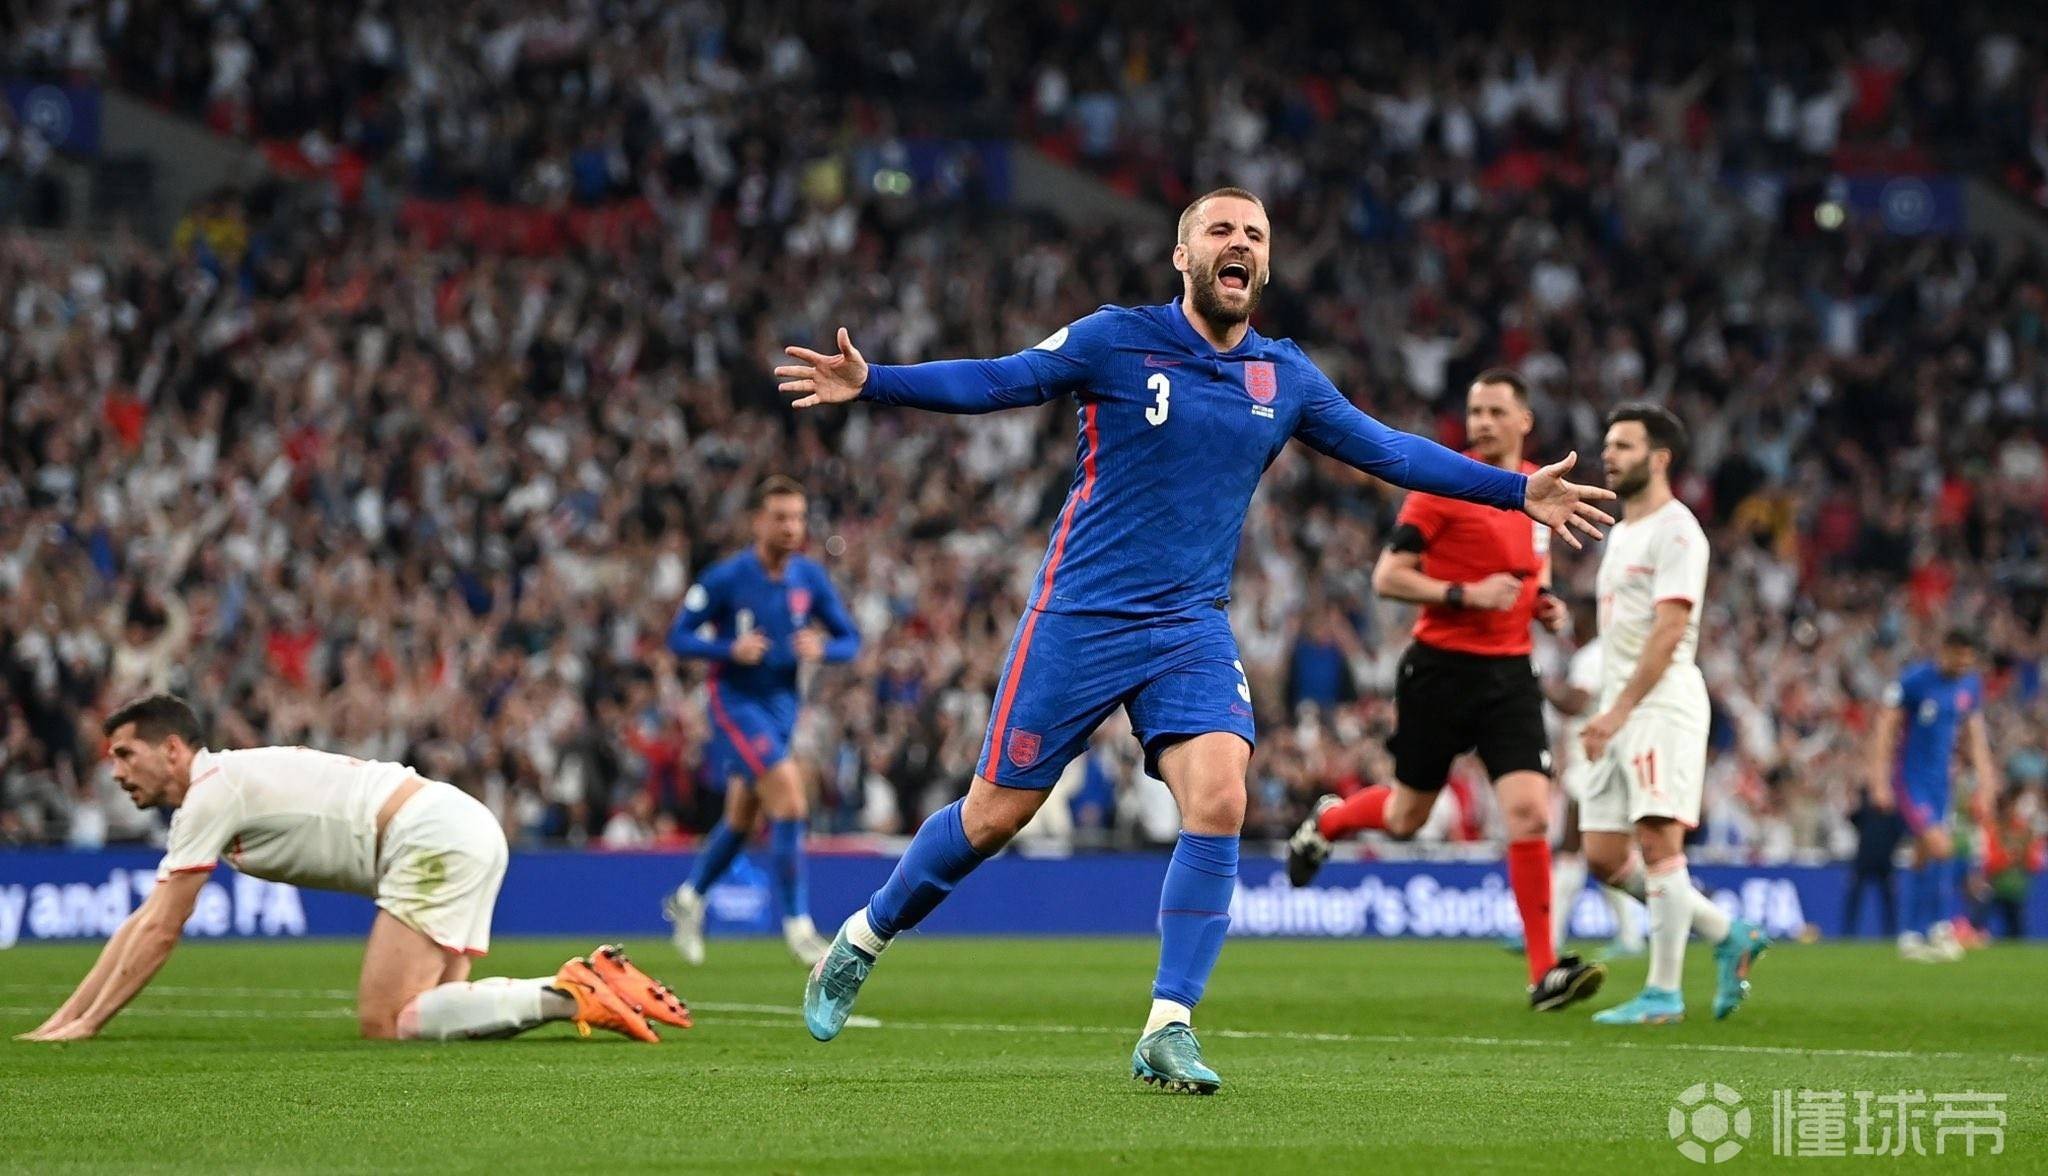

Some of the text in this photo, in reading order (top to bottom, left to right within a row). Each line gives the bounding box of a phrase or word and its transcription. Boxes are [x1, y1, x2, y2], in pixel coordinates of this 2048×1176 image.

[1145, 372, 1171, 427] 3
[1632, 749, 1657, 788] 11
[28, 868, 132, 938] and
[235, 873, 307, 937] FA
